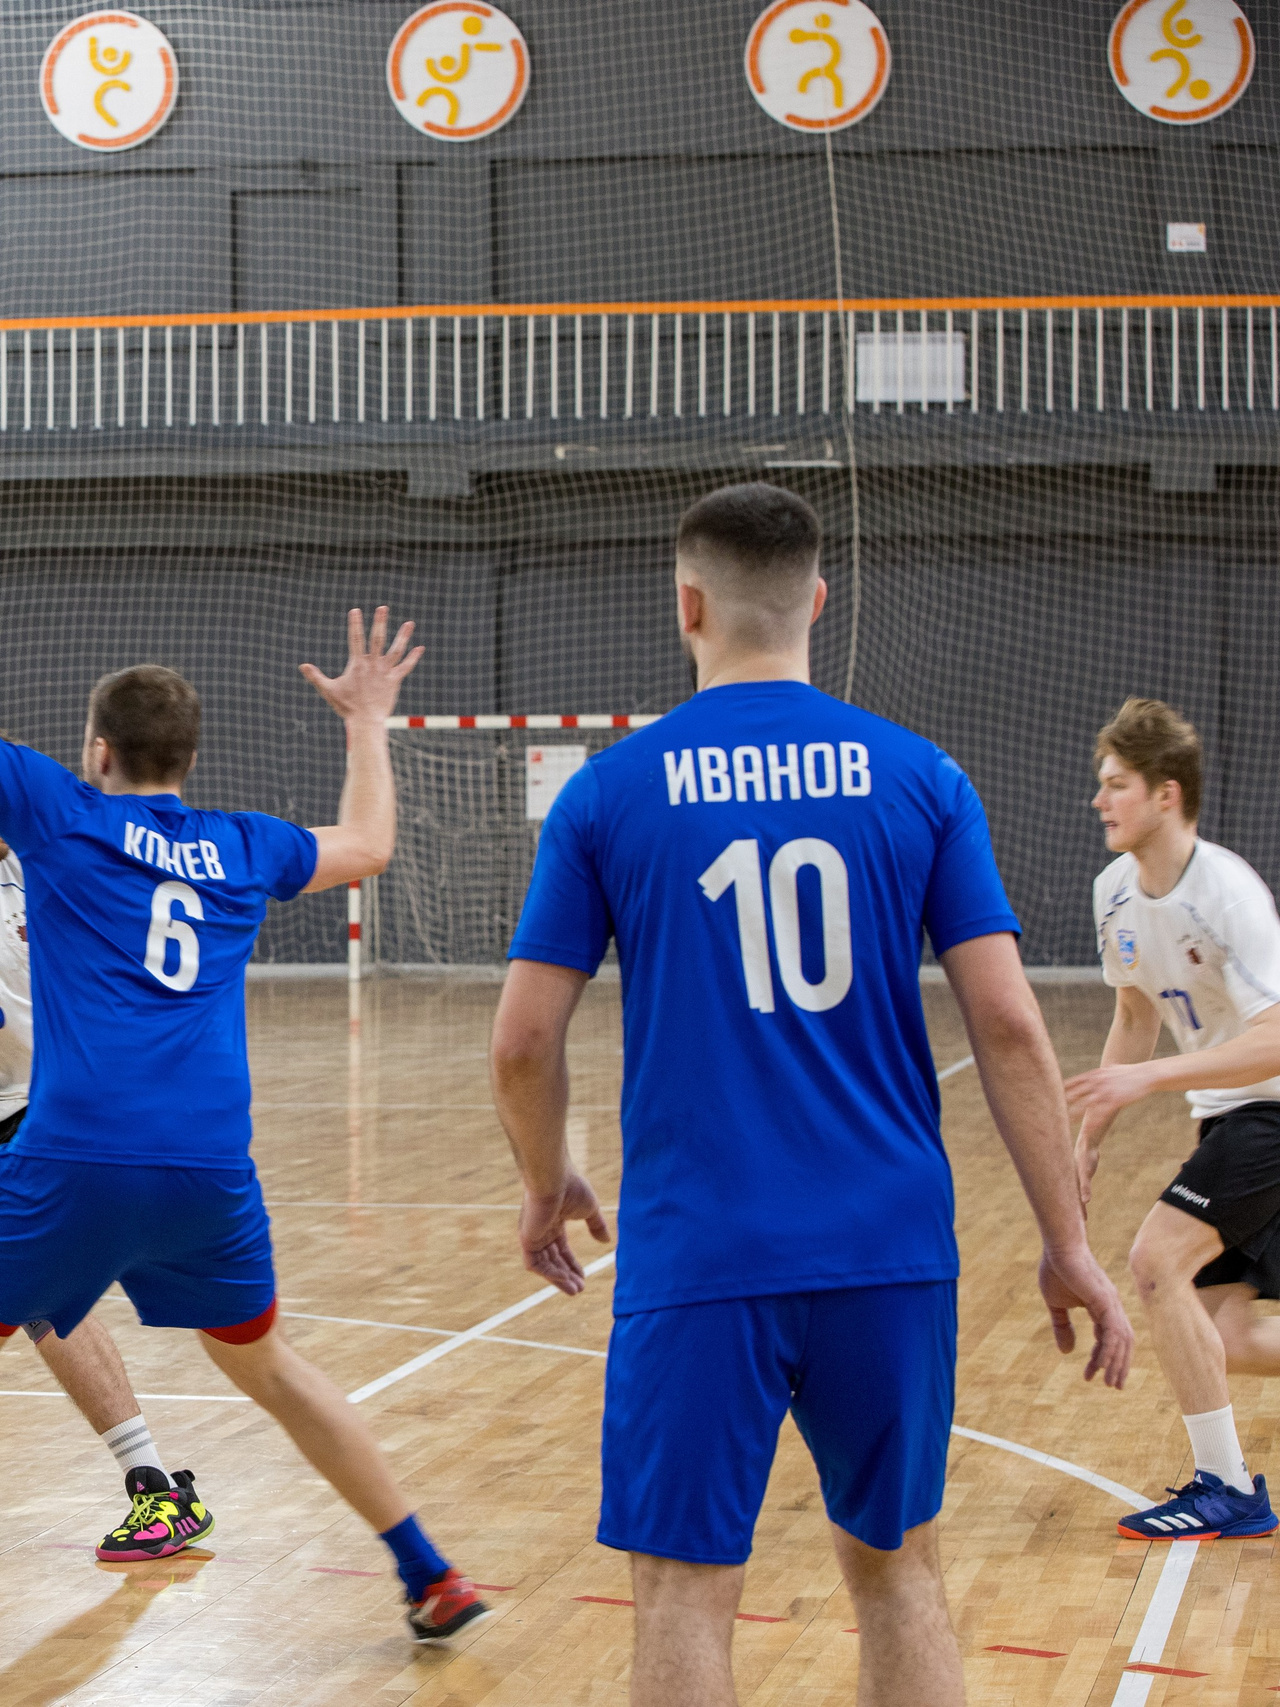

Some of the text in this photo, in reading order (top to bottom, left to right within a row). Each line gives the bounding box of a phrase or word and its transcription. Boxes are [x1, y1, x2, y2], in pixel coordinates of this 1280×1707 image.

[663, 741, 872, 805] ИВАНОВ
[144, 881, 205, 992] 6
[697, 837, 853, 1013] 10
[1170, 1184, 1210, 1208] uhlsport
